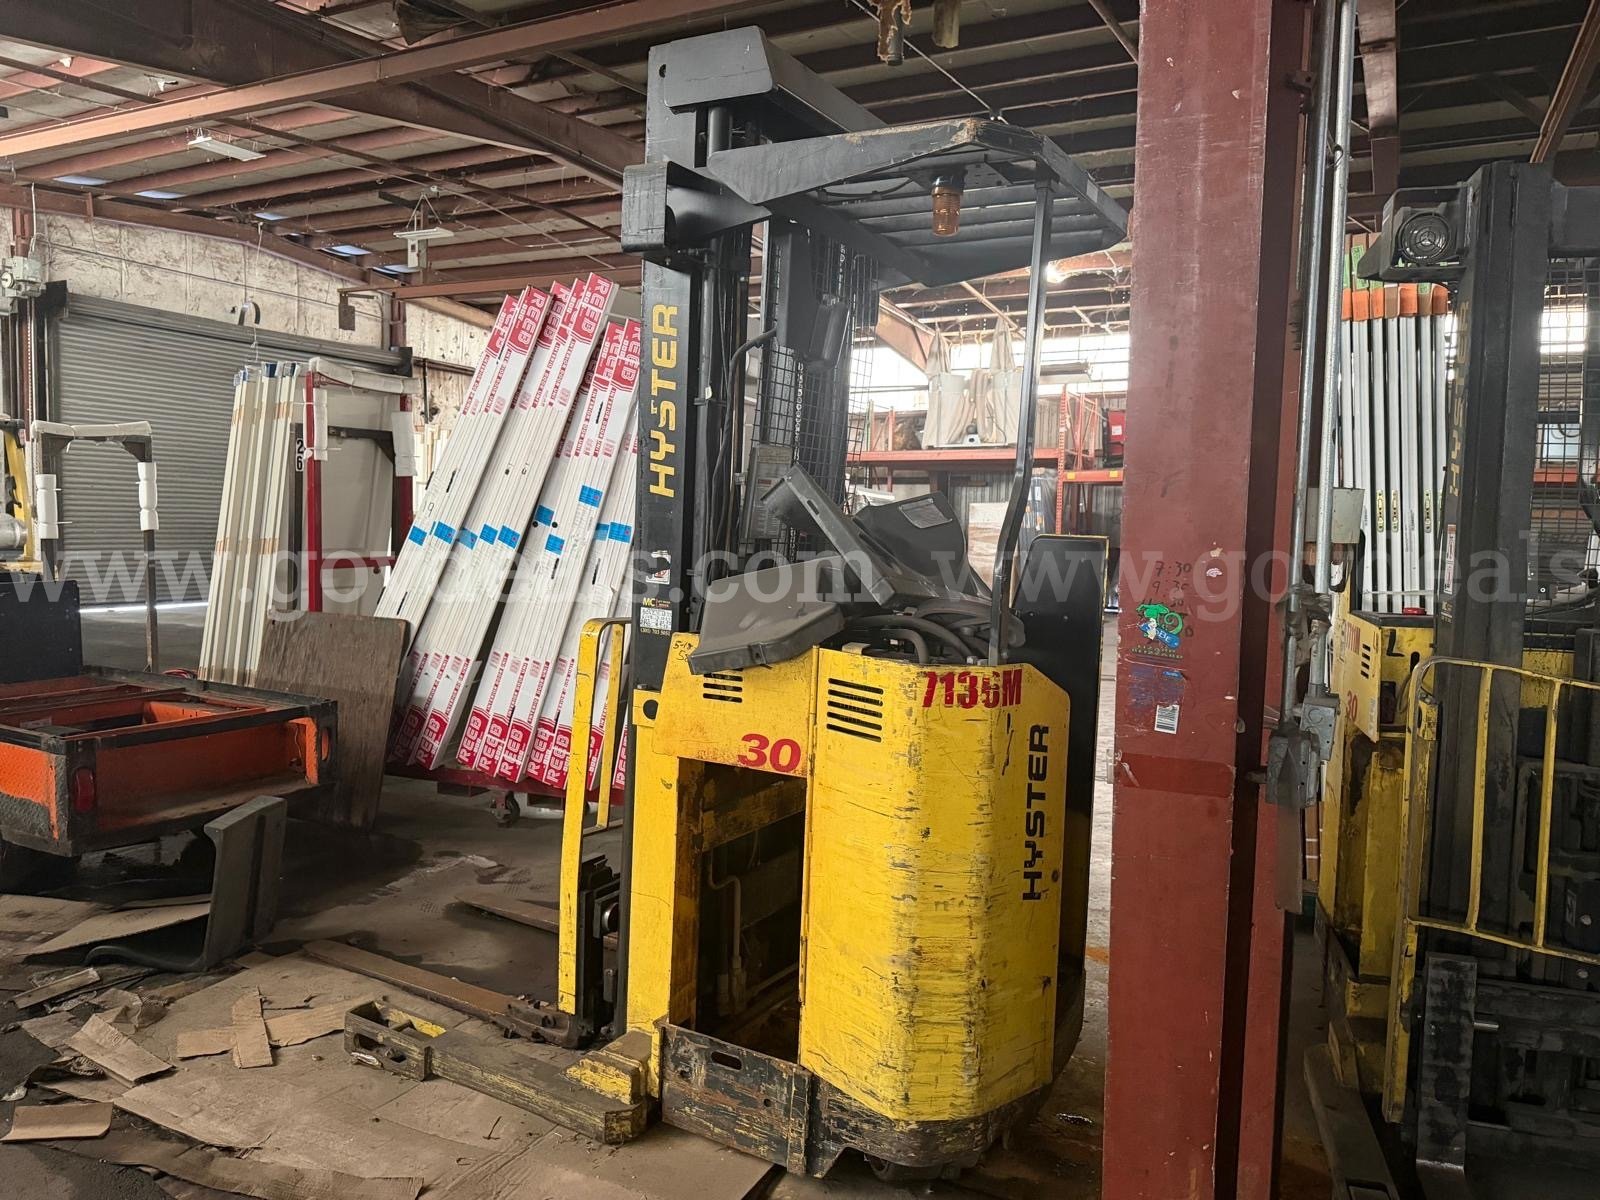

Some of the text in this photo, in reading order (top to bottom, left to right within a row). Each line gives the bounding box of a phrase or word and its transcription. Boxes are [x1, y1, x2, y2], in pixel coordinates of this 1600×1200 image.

[517, 292, 547, 345] REEB
[543, 287, 571, 340] REEB
[581, 279, 611, 334] REEB
[545, 344, 560, 370] INTERIO
[649, 304, 677, 498] HYSTER
[642, 597, 656, 607] MC
[416, 718, 441, 763] REEB
[458, 715, 482, 762] REEB
[478, 723, 503, 771] REEB
[500, 728, 524, 776] REEB
[527, 727, 550, 776] REEB
[547, 734, 569, 783] REEB
[737, 733, 801, 772] 30
[1022, 724, 1049, 901] HYSTER
